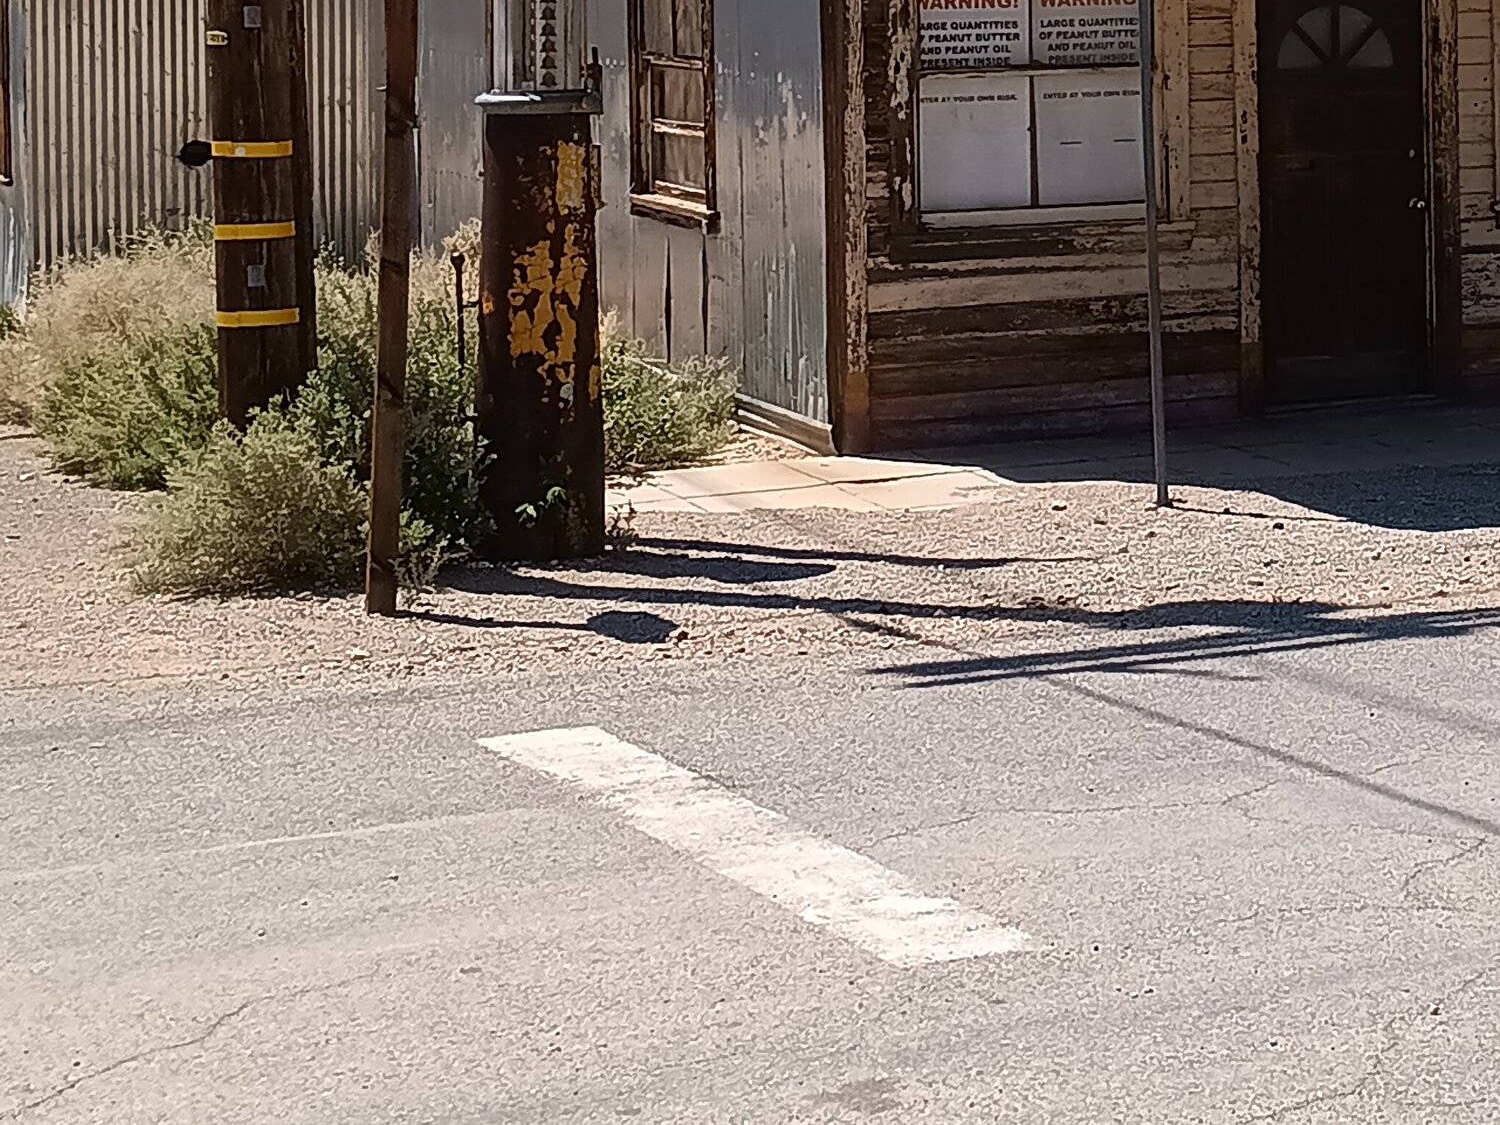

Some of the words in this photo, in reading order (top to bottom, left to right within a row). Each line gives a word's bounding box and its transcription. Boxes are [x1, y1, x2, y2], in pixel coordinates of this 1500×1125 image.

[920, 21, 948, 31] ARGE
[950, 20, 1019, 31] QUANTITIES
[1040, 18, 1076, 28] LARGE
[1078, 17, 1139, 27] QUANTITIE
[928, 33, 973, 43] PEANUT
[975, 32, 1021, 42] BUTTER
[1038, 31, 1054, 40] OF
[1056, 30, 1100, 40] PEANUT
[1102, 29, 1139, 38] BUTTE
[920, 46, 942, 56] AND
[945, 45, 990, 55] PEANUT
[993, 44, 1012, 53] OIL
[1047, 42, 1070, 52] AND
[1072, 41, 1115, 51] PEANUT
[1118, 40, 1137, 50] OIL
[920, 57, 970, 69] PRESENT
[973, 57, 1011, 67] INSIDE
[1048, 54, 1096, 66] PRESENT
[1099, 52, 1136, 62] INSIDE
[920, 95, 939, 104] NTER
[954, 95, 975, 103] YOUR
